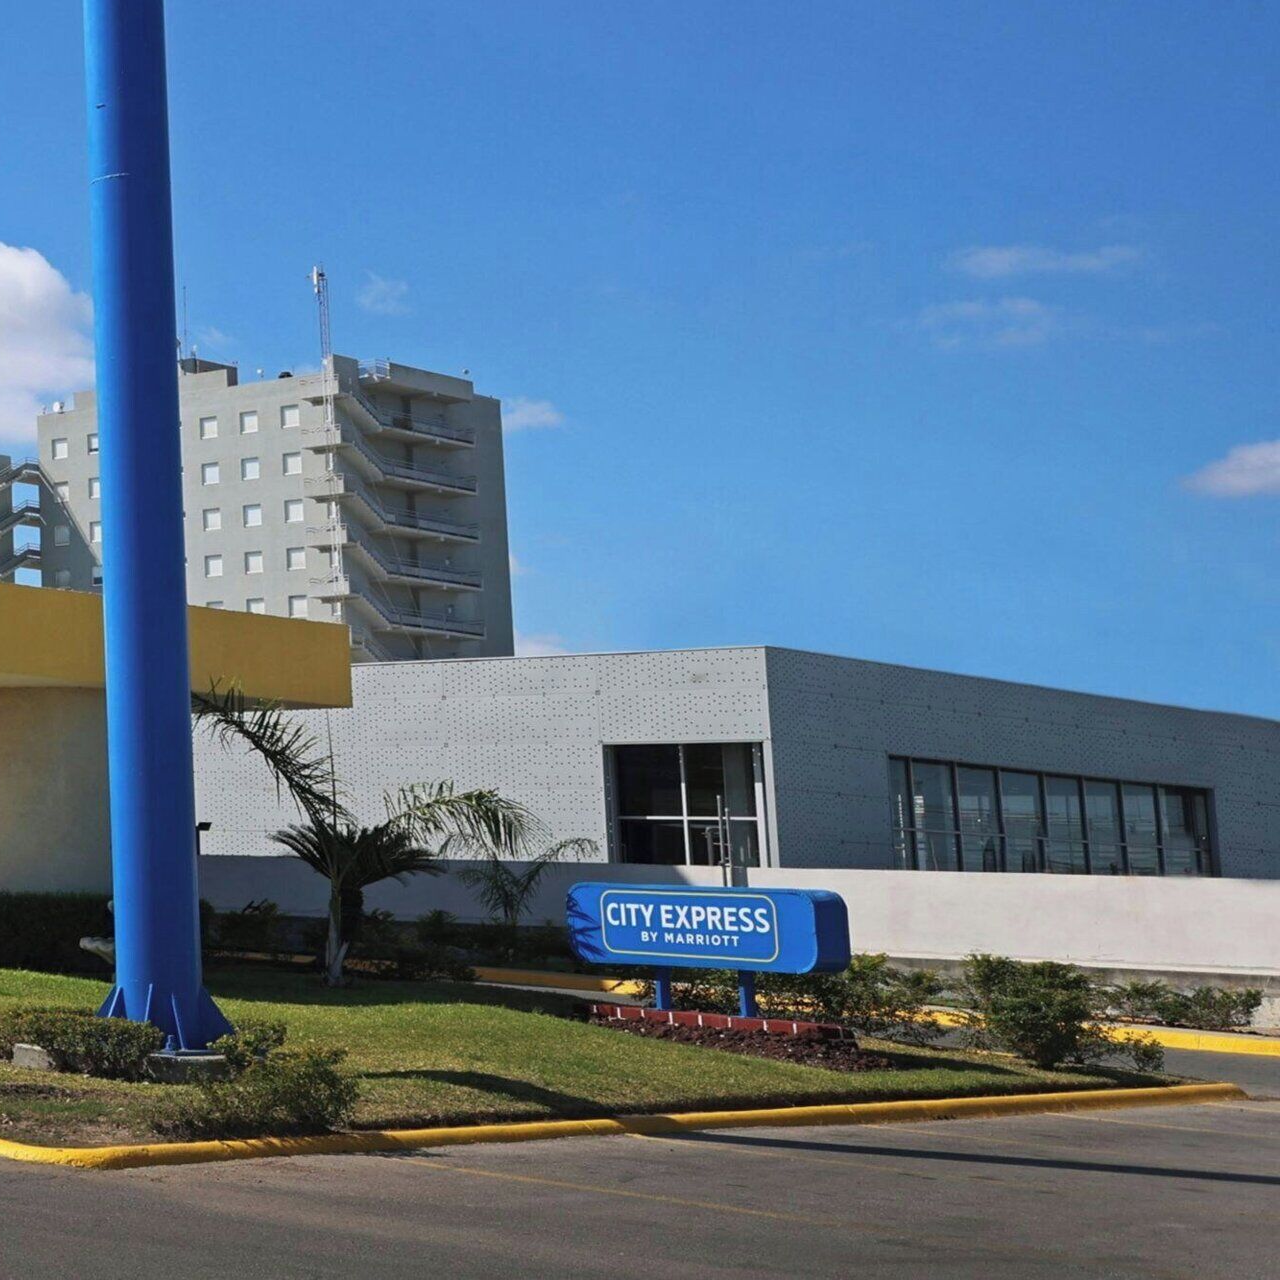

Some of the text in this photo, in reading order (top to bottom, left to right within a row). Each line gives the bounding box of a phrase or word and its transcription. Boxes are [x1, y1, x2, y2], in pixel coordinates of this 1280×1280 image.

[606, 902, 771, 934] CITY EXPRESS
[640, 930, 740, 947] BY MARRIOTT
